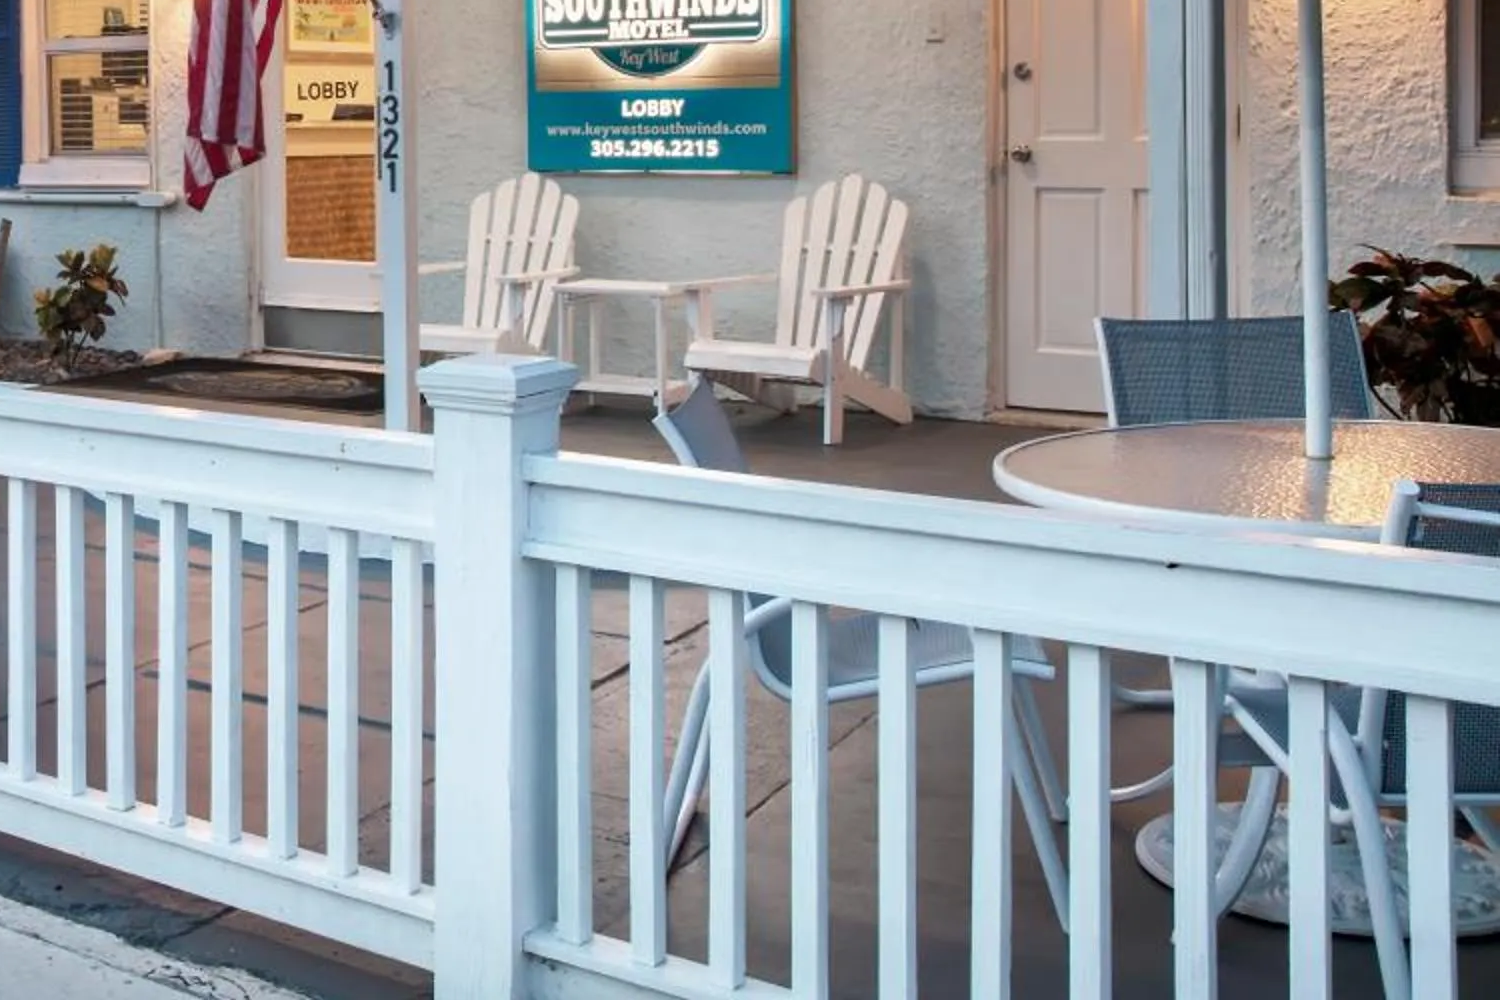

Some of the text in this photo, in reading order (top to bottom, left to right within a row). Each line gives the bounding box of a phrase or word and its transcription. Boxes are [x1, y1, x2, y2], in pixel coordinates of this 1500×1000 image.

[608, 19, 689, 40] MOTEL
[620, 47, 680, 68] Key West
[297, 81, 359, 101] LOBBY
[620, 98, 686, 118] LOBBY
[382, 60, 399, 193] 1321
[546, 120, 767, 138] www.keywestsouthwinds.com
[590, 138, 721, 158] 305.296.2215
